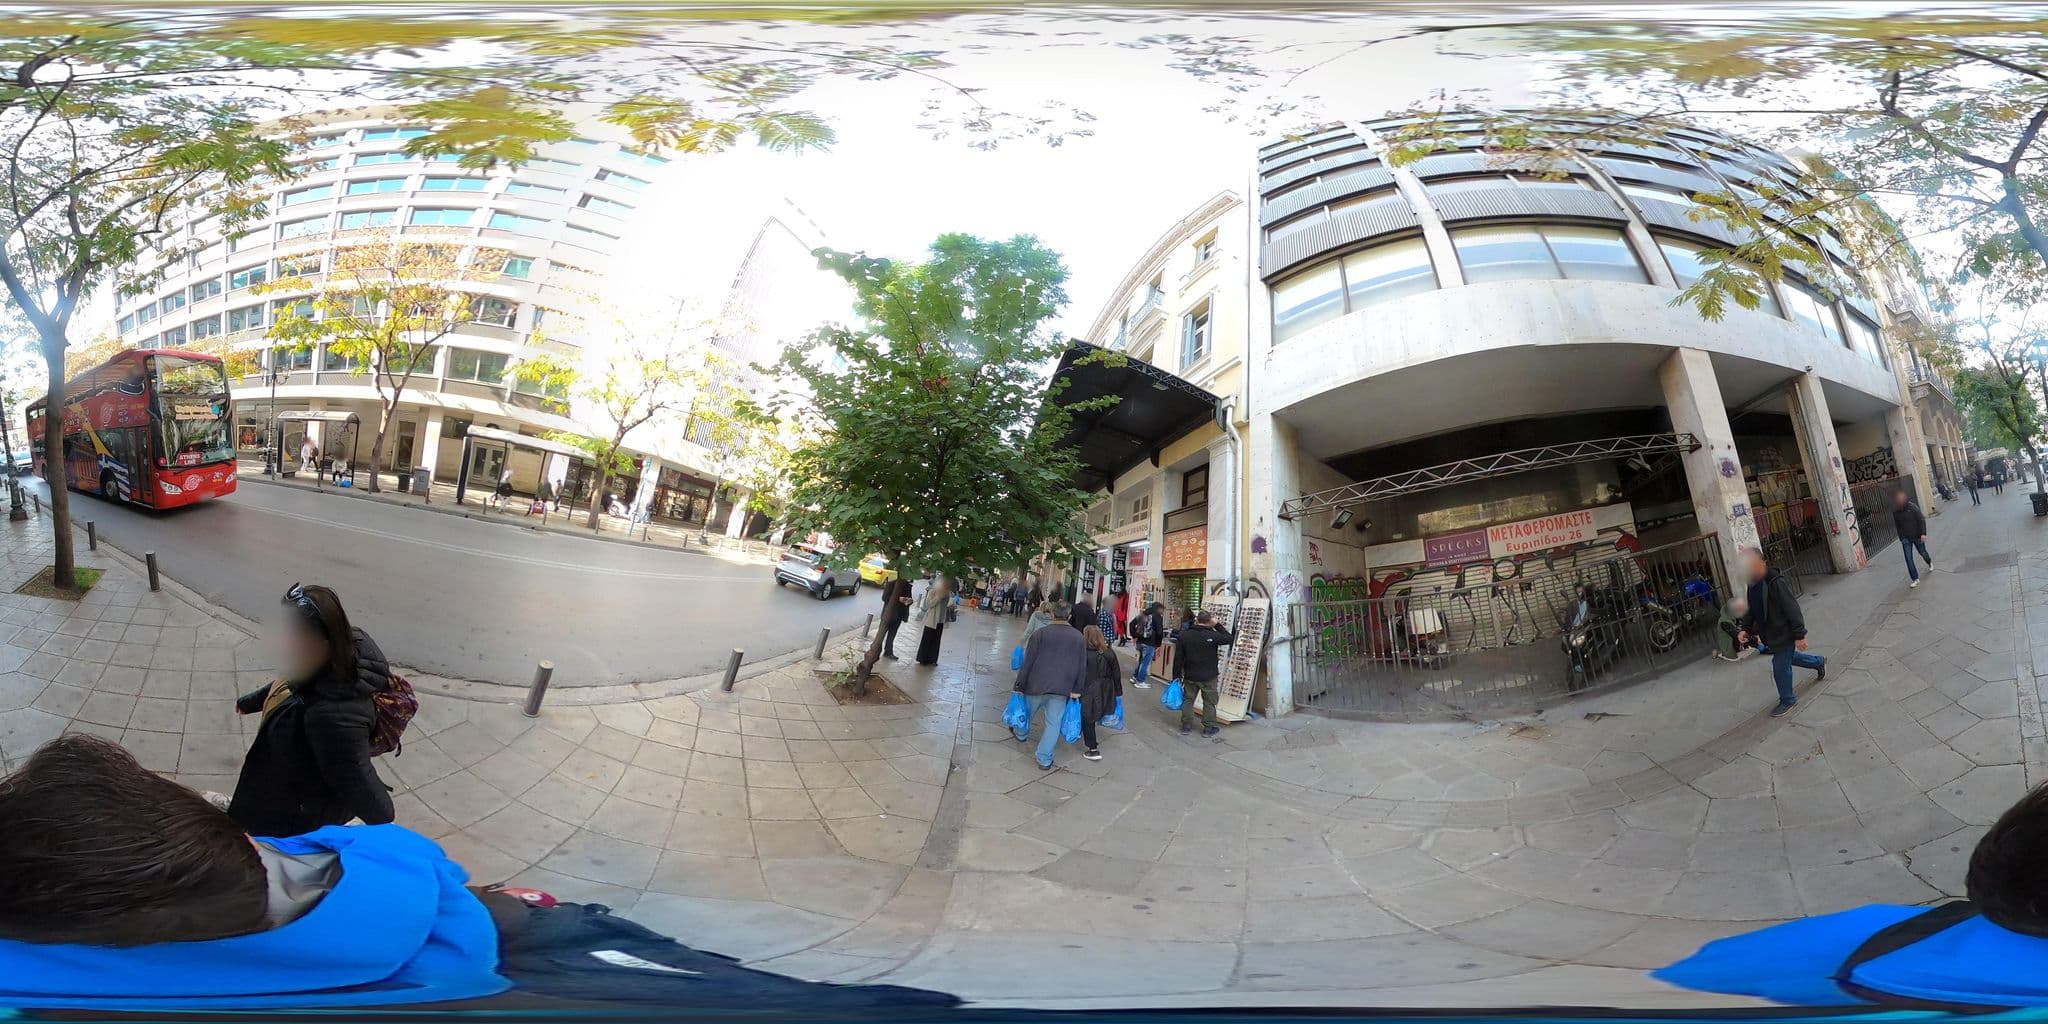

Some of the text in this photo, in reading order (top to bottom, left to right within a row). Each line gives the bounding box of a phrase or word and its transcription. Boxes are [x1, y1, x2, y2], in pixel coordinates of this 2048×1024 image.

[1490, 511, 1593, 542] ΜΕΤΑΦΕΡΟΜΑΣΤΕ
[1506, 529, 1583, 552] Ευριπίδου 26
